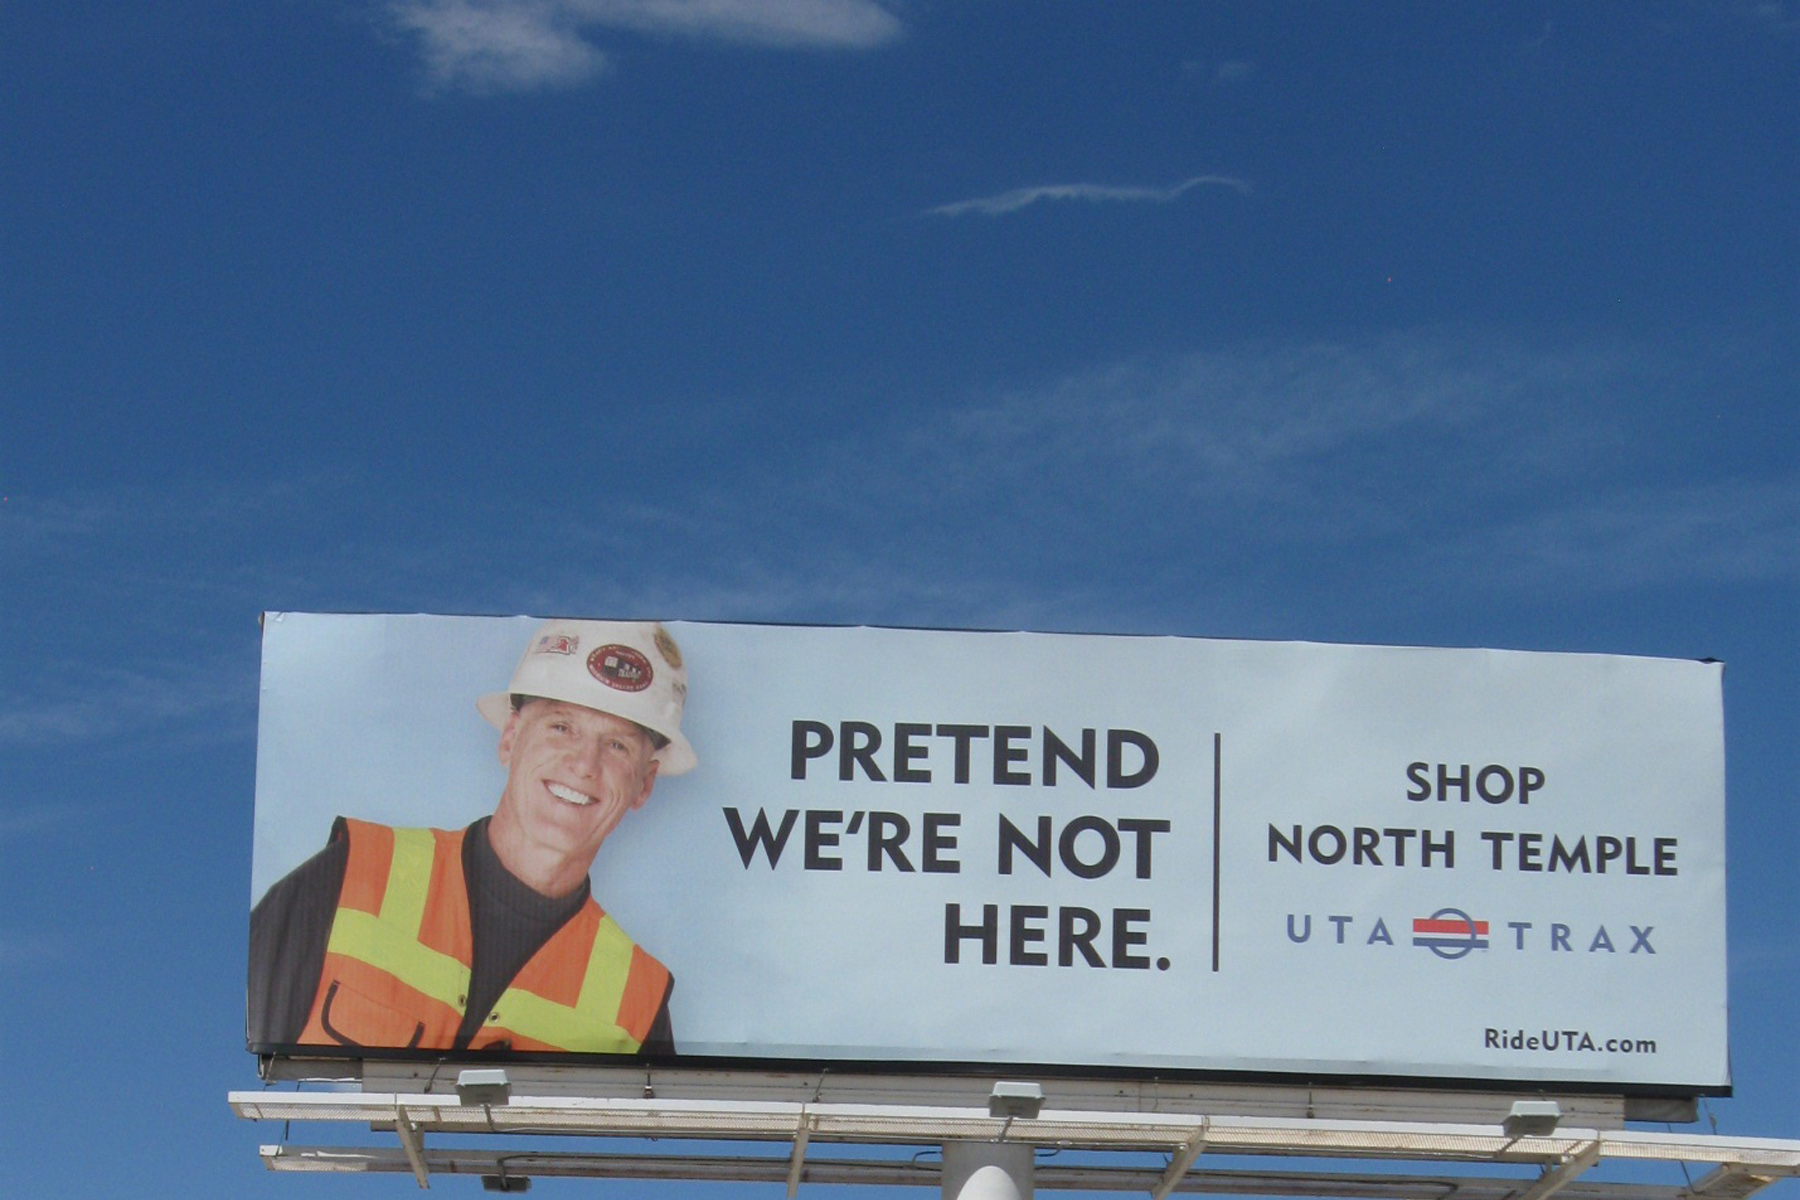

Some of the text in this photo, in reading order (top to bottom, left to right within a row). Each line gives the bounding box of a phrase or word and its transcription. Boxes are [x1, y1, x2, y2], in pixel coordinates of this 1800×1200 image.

[791, 721, 1159, 789] PRETEND
[1407, 762, 1545, 804] SHOP
[723, 807, 1170, 880] WE'RE NOT
[1269, 824, 1677, 876] NORTH TEMPLE
[945, 904, 1170, 971] HERE.
[1287, 914, 1656, 955] UTA TRAX
[1485, 1028, 1656, 1053] RideUTA.com
